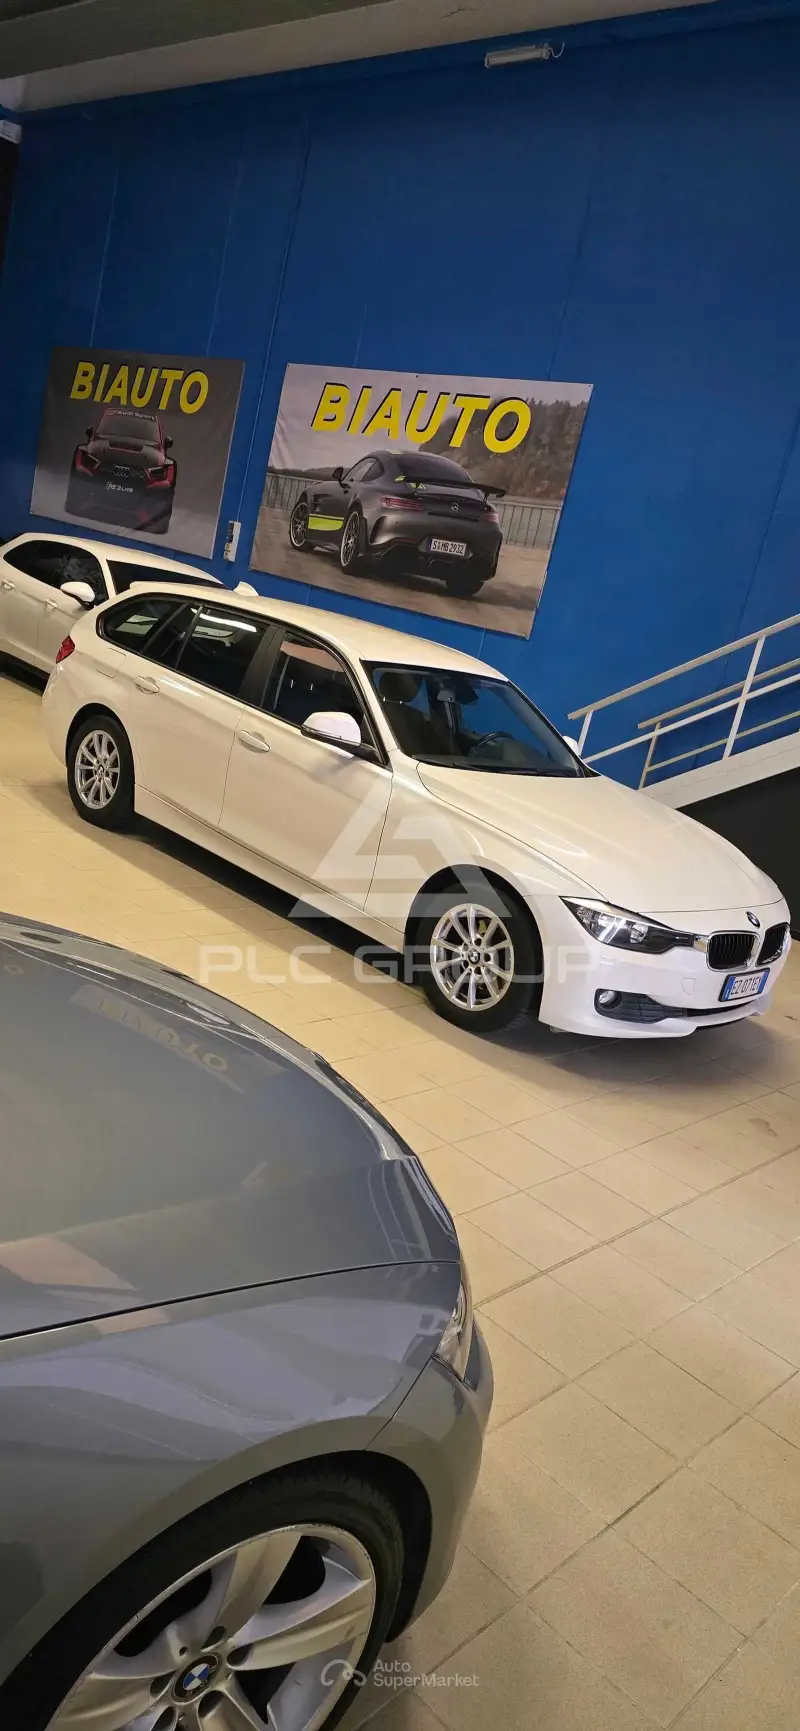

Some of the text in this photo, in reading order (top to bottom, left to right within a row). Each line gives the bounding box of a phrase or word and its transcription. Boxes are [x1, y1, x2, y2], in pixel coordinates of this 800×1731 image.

[69, 360, 209, 414] BIAUTO
[134, 412, 155, 421] Sport
[311, 382, 531, 453] BIAUTO
